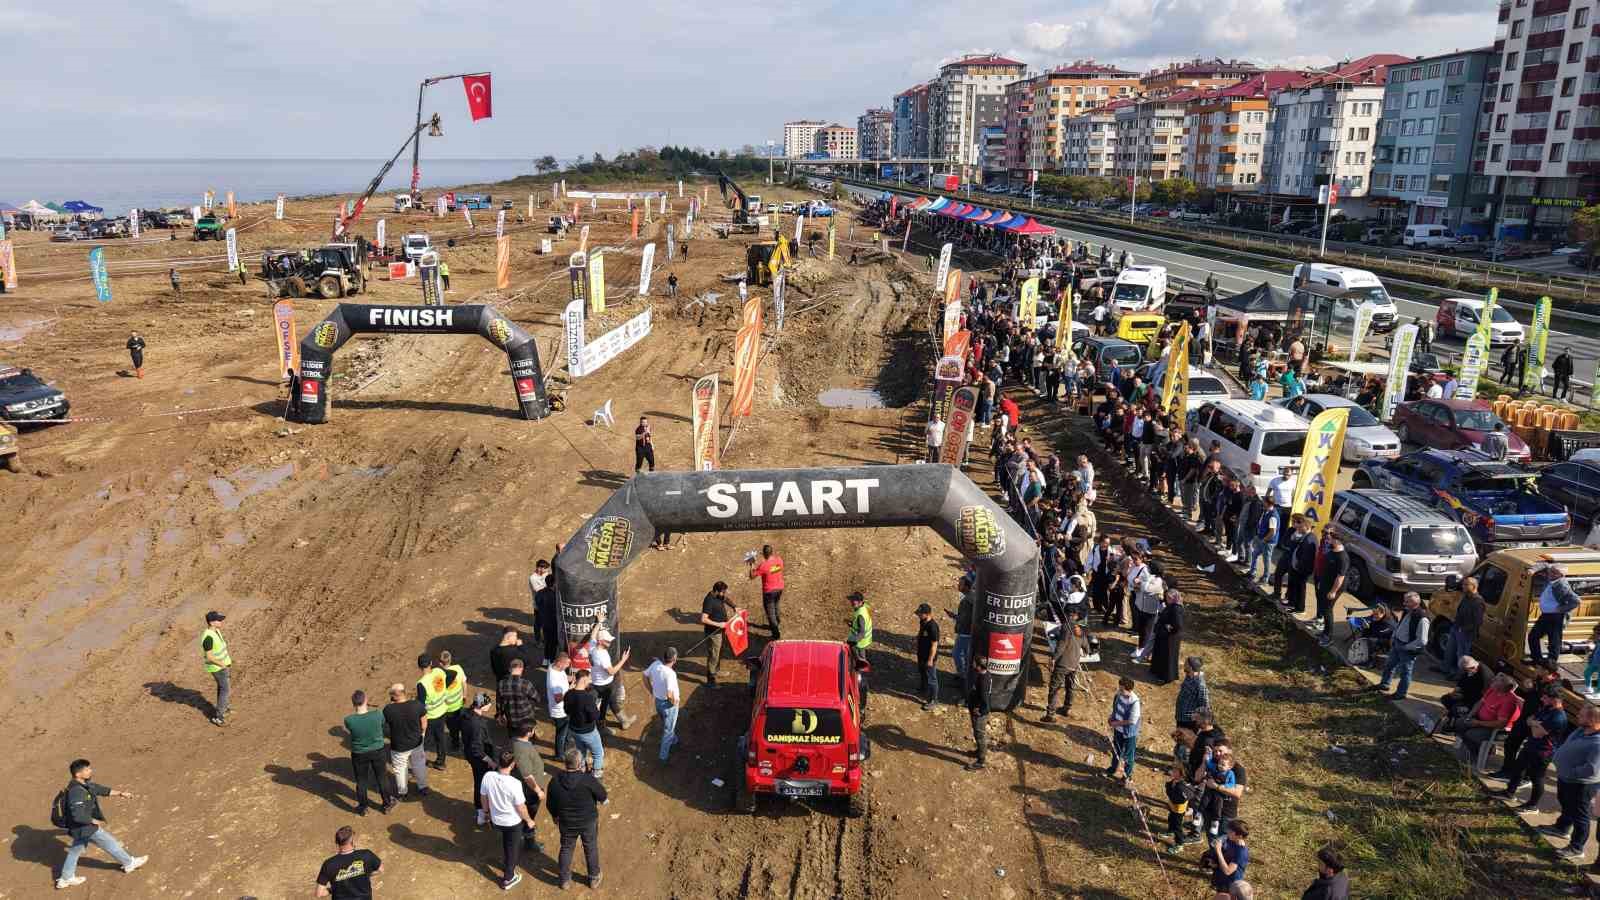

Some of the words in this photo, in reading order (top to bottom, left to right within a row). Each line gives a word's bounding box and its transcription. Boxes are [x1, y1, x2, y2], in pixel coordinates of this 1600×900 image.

[369, 308, 454, 327] FINISH
[705, 478, 880, 519] START
[595, 522, 616, 569] MACERA
[986, 594, 1002, 608] ER
[1003, 595, 1034, 609] LİDER
[987, 611, 1030, 624] PETROL
